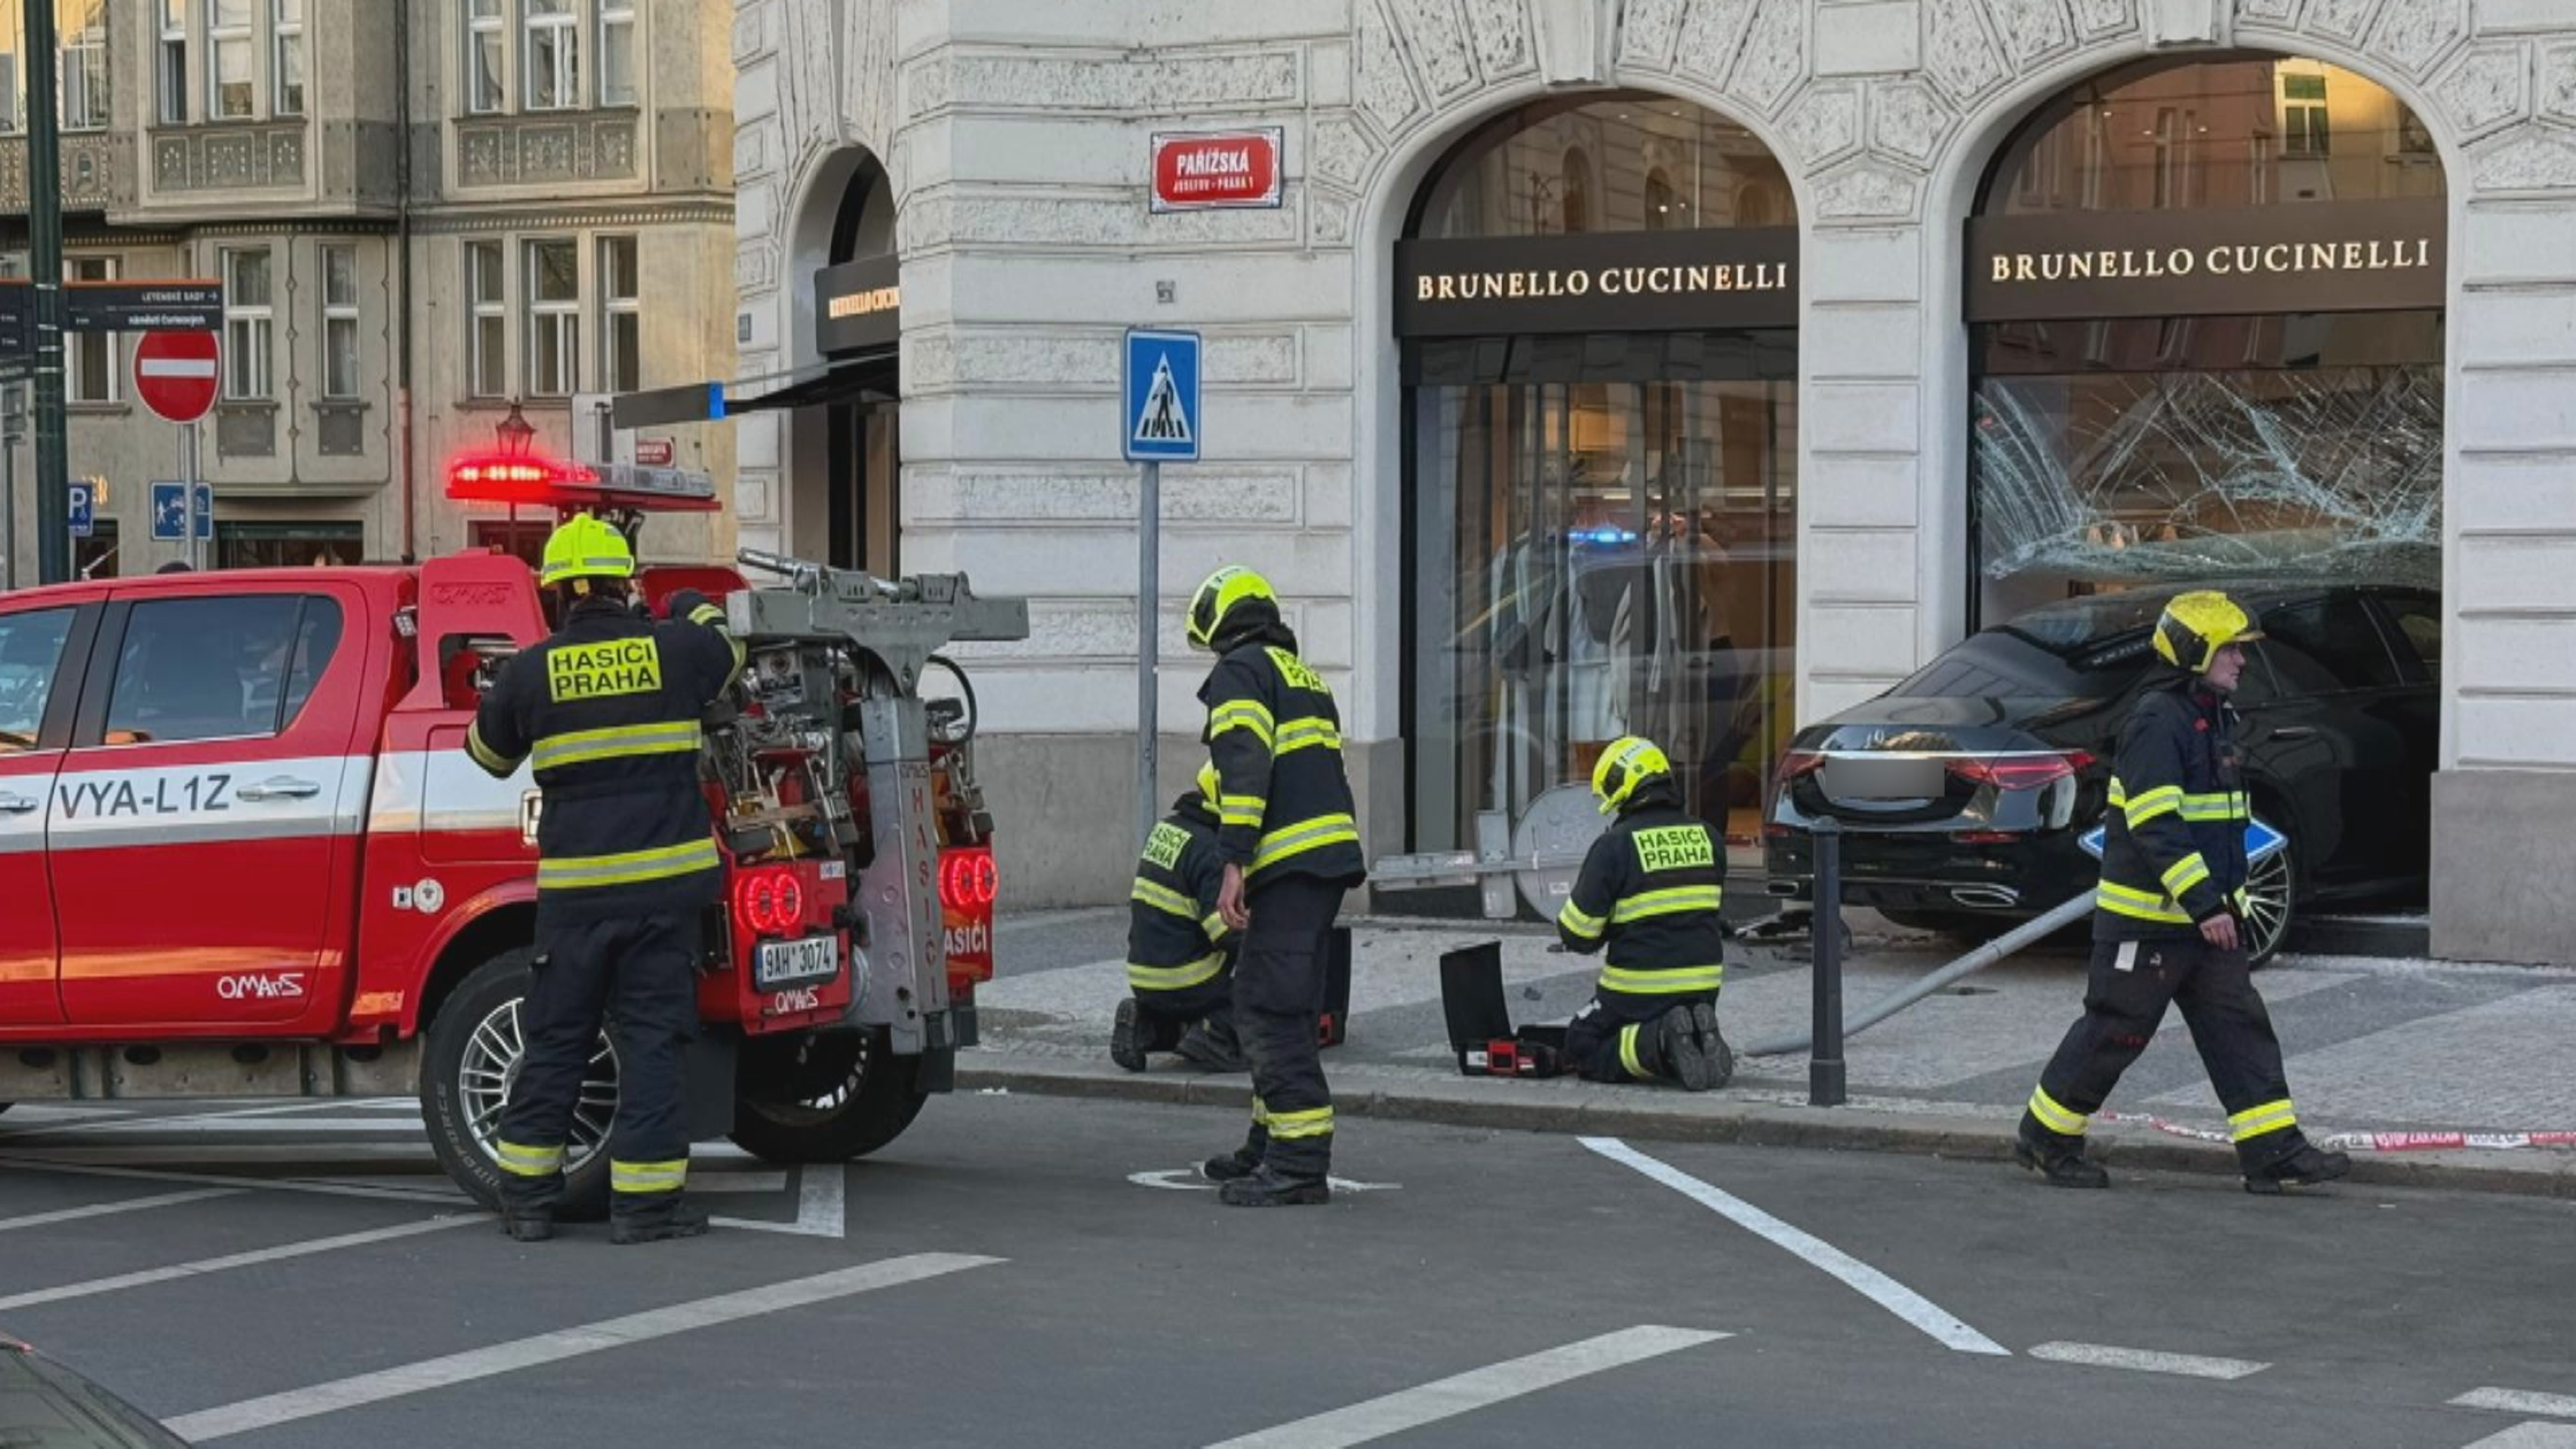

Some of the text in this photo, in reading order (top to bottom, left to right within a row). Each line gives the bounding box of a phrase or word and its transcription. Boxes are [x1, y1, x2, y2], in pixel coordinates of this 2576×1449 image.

[1177, 147, 1249, 176] PAŘÍŽSKÁ
[1218, 177, 1246, 189] PRAHA
[1249, 176, 1254, 188] 1
[1992, 239, 2430, 281] BRUNELLO CUCINELLI
[141, 291, 181, 302] LETENSKÉ
[1417, 263, 1787, 300] BRUNELLO CUCINELLI
[553, 642, 653, 673] HASIČI
[556, 666, 655, 698] PRAHA
[60, 774, 231, 819] VYA-L1Z
[1638, 828, 1707, 850] HASIČI
[1644, 846, 1710, 869] PRAHA
[944, 918, 987, 956] ASIČI
[765, 940, 830, 977] 9AH 3074
